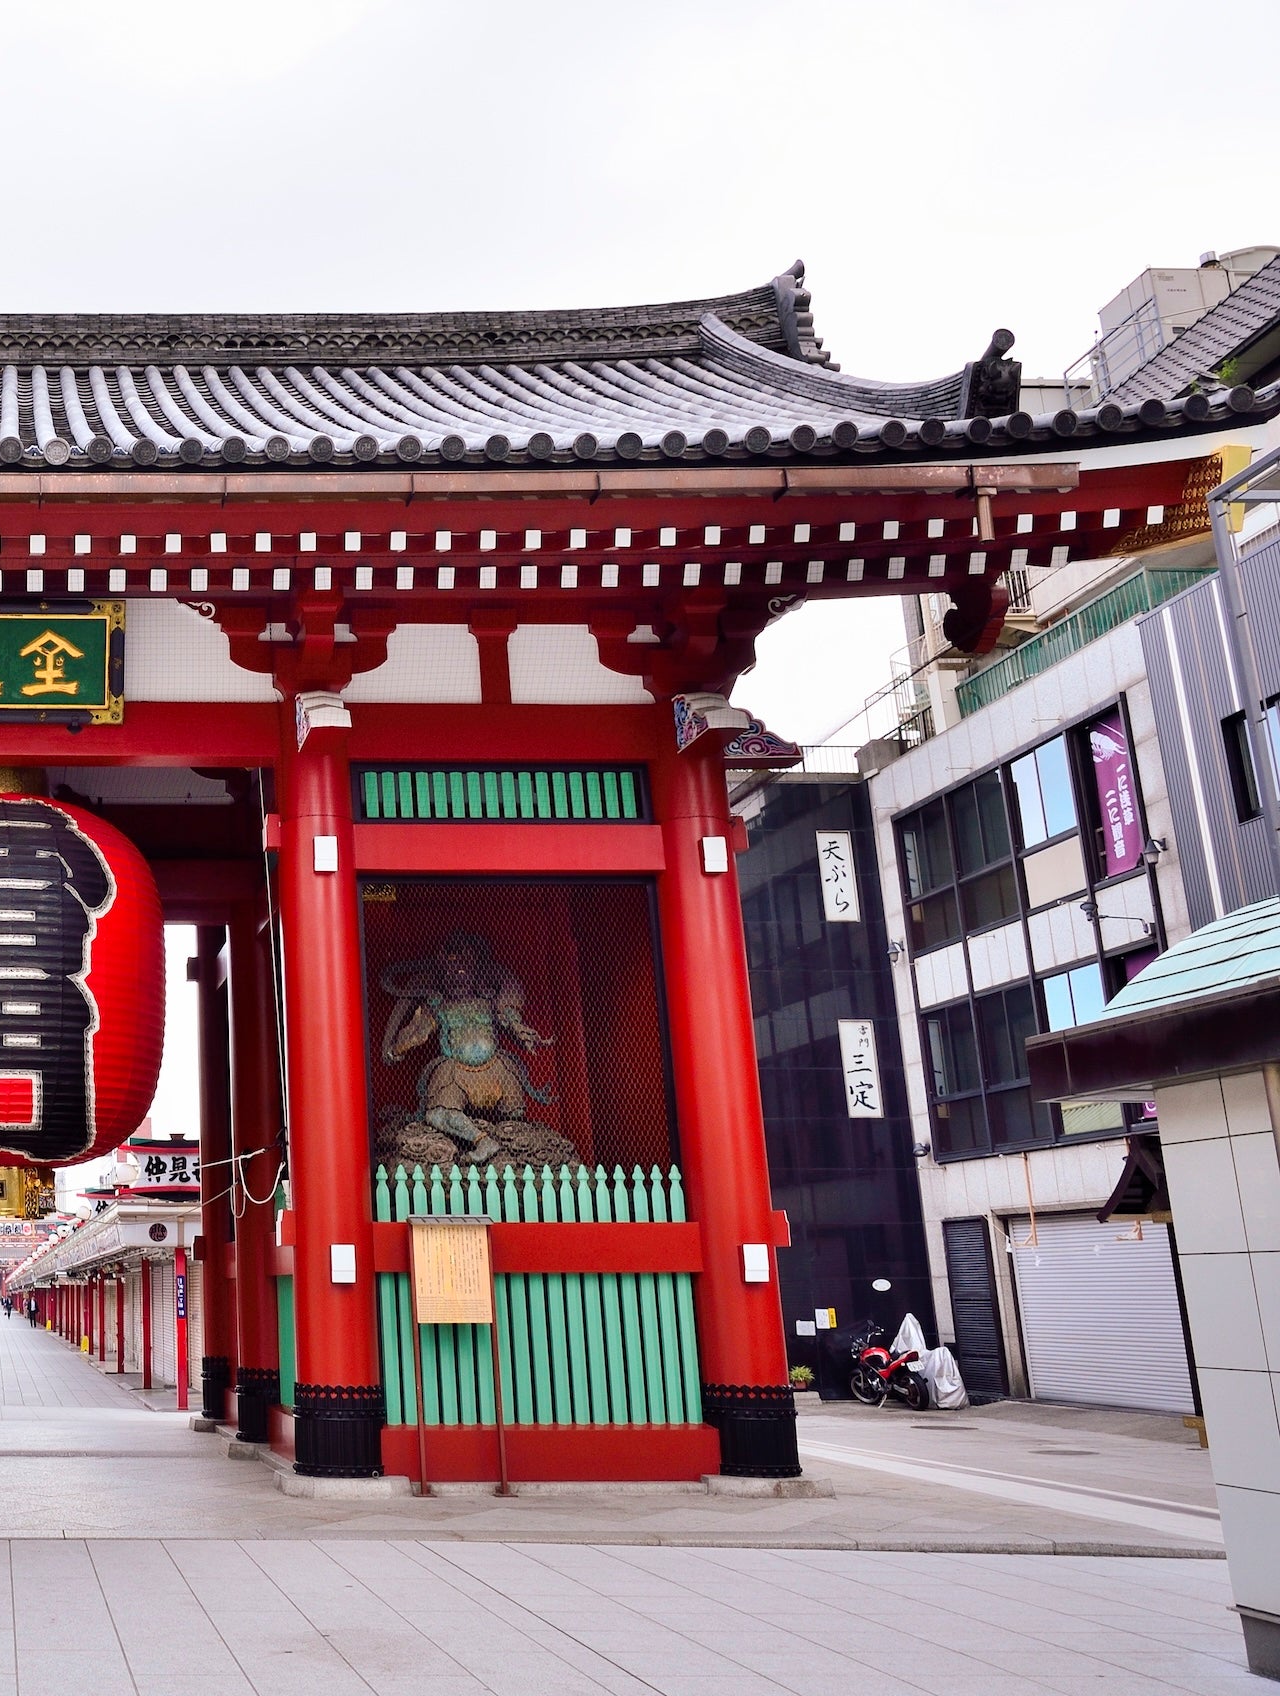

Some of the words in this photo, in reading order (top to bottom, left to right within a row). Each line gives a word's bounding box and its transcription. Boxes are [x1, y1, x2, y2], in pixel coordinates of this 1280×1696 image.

[822, 840, 850, 913] 天ぷら
[858, 1024, 870, 1048] 雷門
[847, 1054, 878, 1110] 三定
